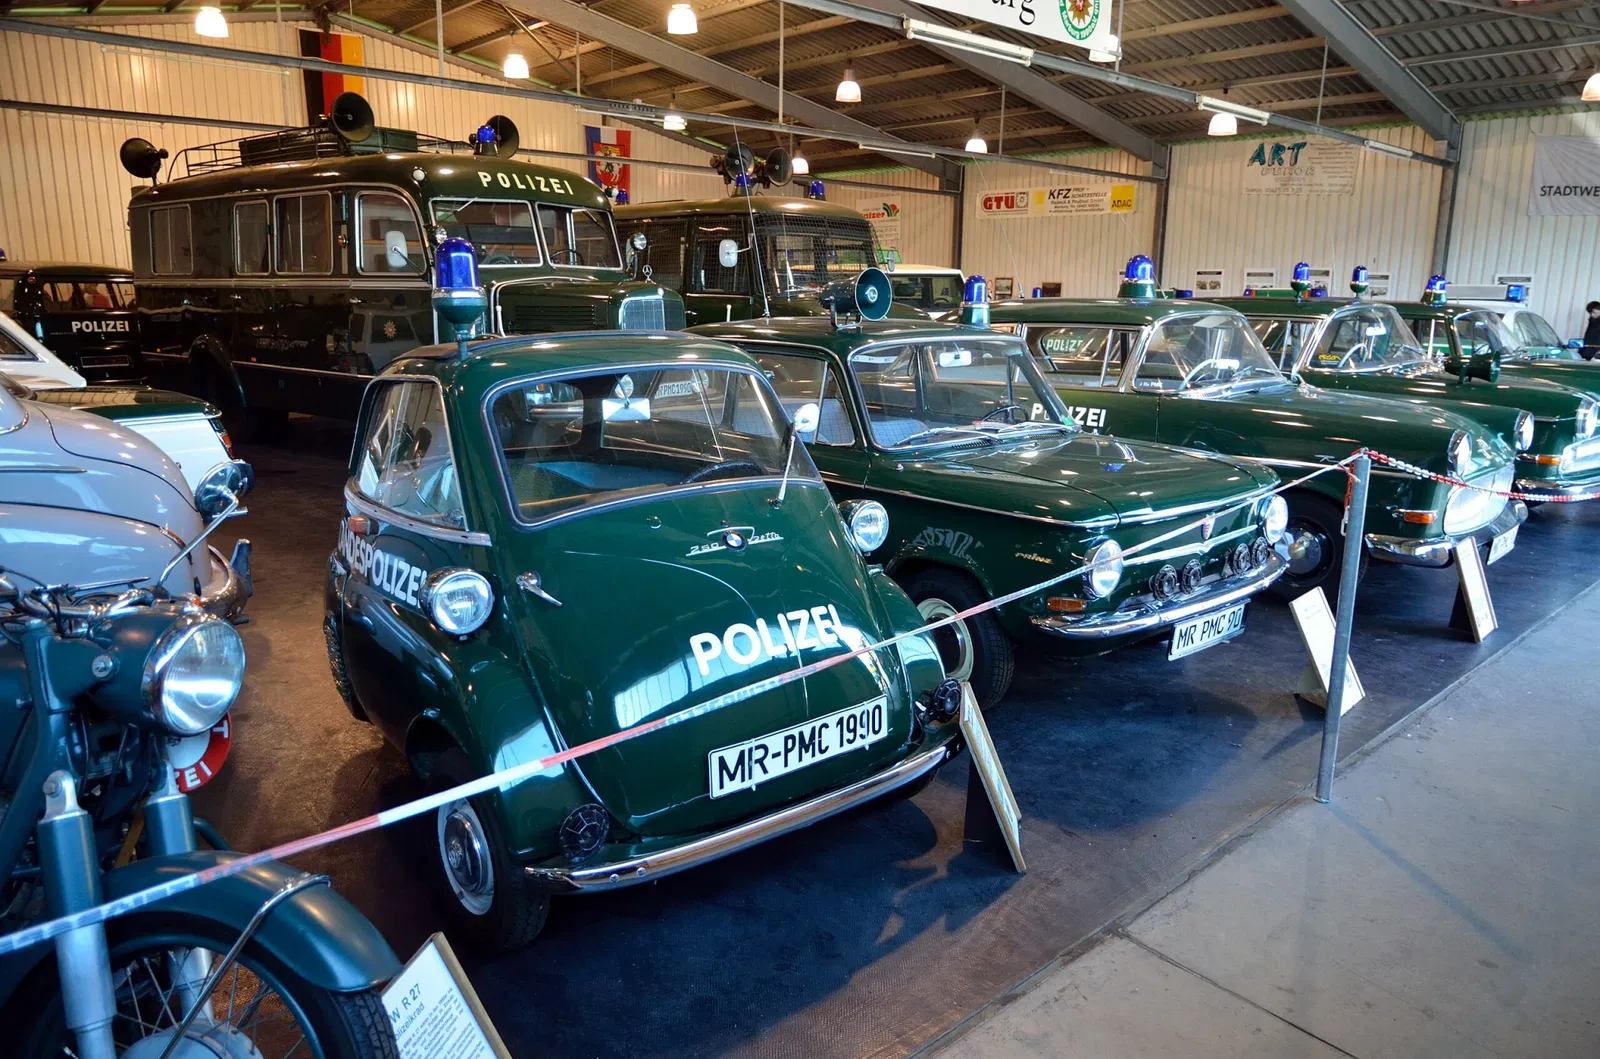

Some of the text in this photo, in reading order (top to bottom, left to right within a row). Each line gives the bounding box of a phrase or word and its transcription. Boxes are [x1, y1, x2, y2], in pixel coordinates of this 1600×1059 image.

[1247, 142, 1307, 167] ART
[477, 171, 574, 195] POLIZEI
[1048, 188, 1072, 199] KFZ
[1112, 199, 1132, 208] ADAC
[71, 320, 130, 333] POLIZEI
[1030, 402, 1107, 428] PIZEI
[690, 542, 719, 554] 250
[689, 603, 846, 676] POLIZEI
[1176, 624, 1197, 650] MR
[1200, 614, 1226, 642] PMC
[718, 704, 882, 790] MR-PMC 1990
[402, 996, 411, 1010] R
[409, 983, 421, 1002] 27
[394, 1002, 425, 1041] olizeikrad
